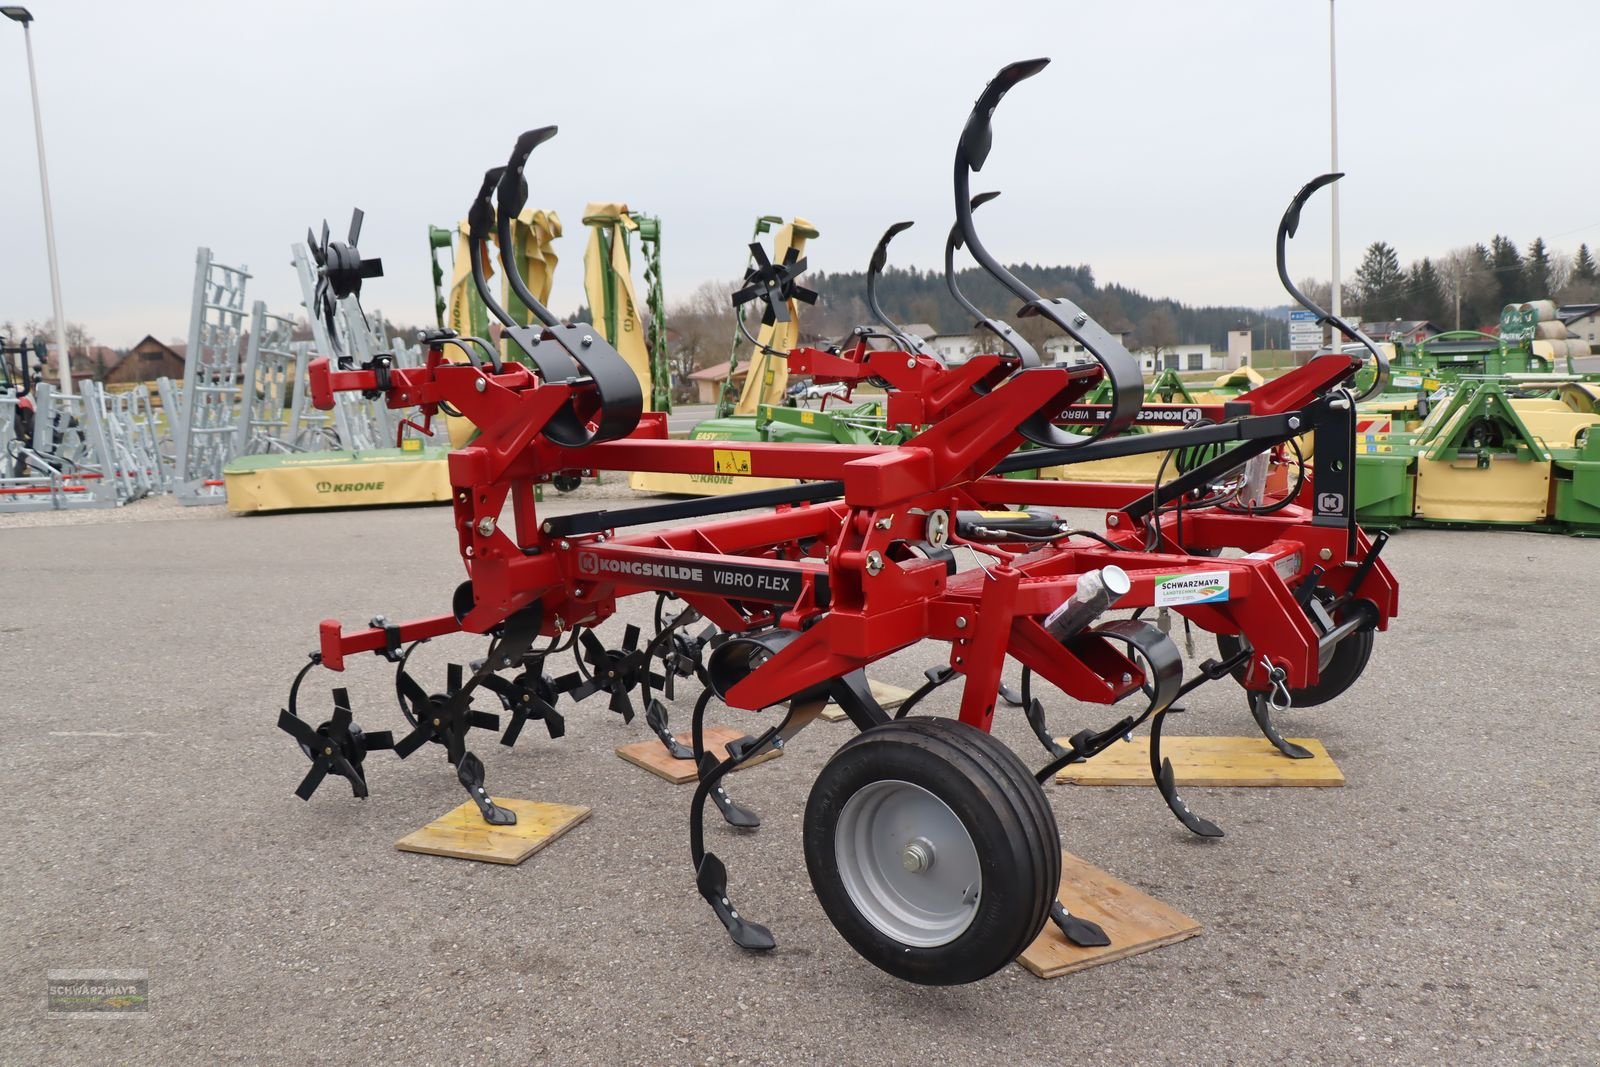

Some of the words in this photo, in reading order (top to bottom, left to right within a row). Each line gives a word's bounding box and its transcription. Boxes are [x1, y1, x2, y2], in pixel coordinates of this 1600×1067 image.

[1061, 410, 1089, 419] VIBRO
[333, 482, 384, 493] KRONE
[600, 558, 703, 582] KONGSKILDE
[713, 570, 754, 588] VIBRO
[757, 575, 790, 592] FLEX
[1162, 579, 1219, 590] SCHWARZMAYR
